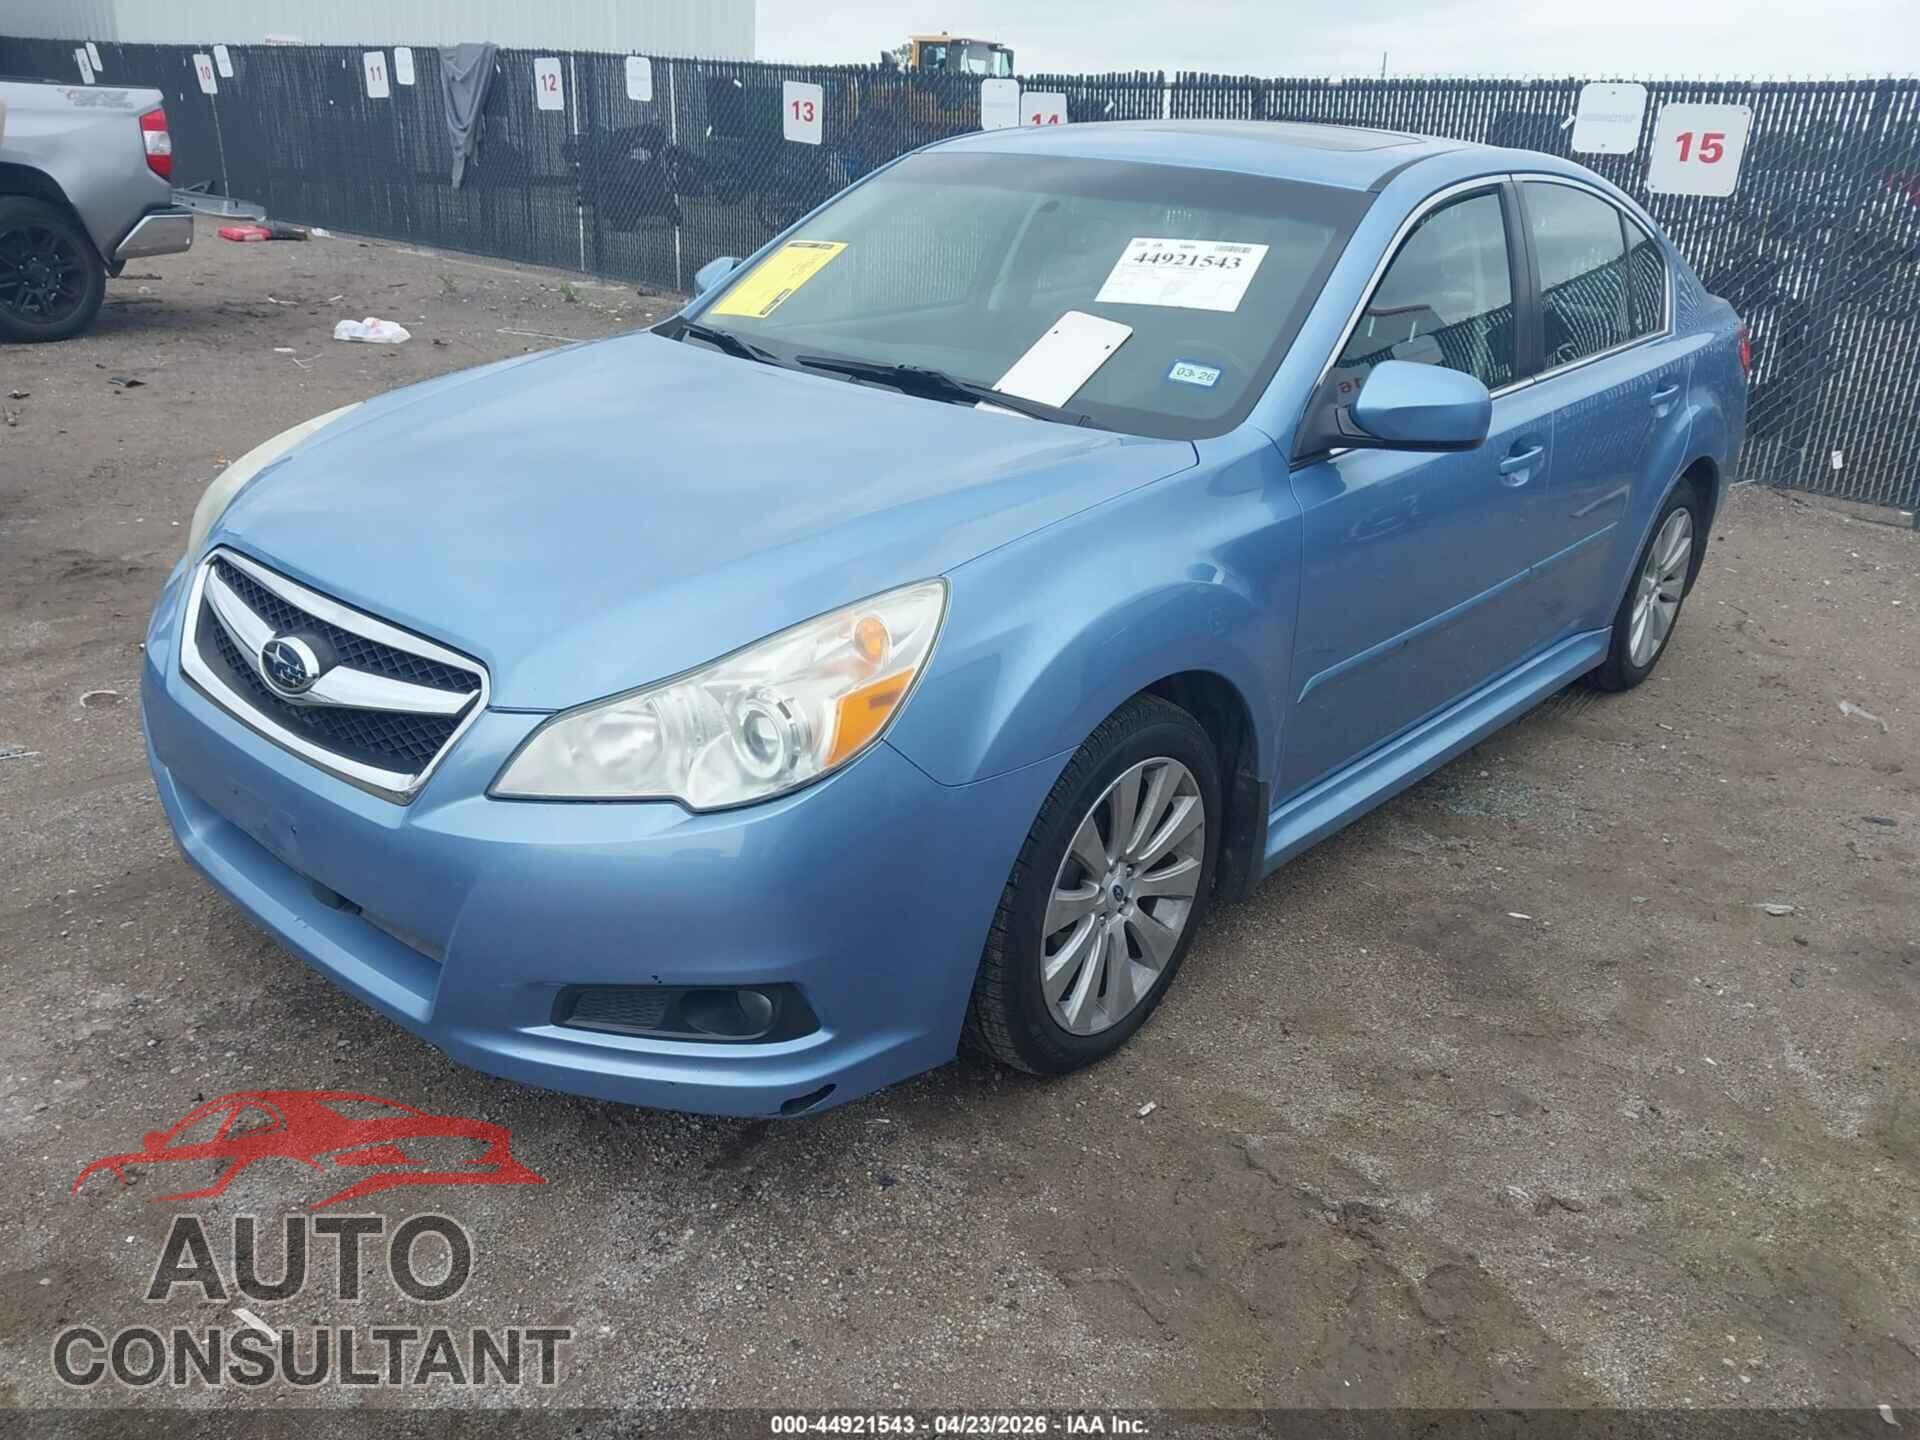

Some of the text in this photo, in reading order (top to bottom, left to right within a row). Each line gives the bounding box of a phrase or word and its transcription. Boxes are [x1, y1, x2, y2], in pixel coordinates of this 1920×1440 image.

[200, 65, 211, 80] 10
[370, 65, 383, 81] 11
[541, 73, 557, 91] 12
[792, 100, 814, 122] 13
[1676, 131, 1725, 164] 15
[1133, 251, 1242, 270] 44921543
